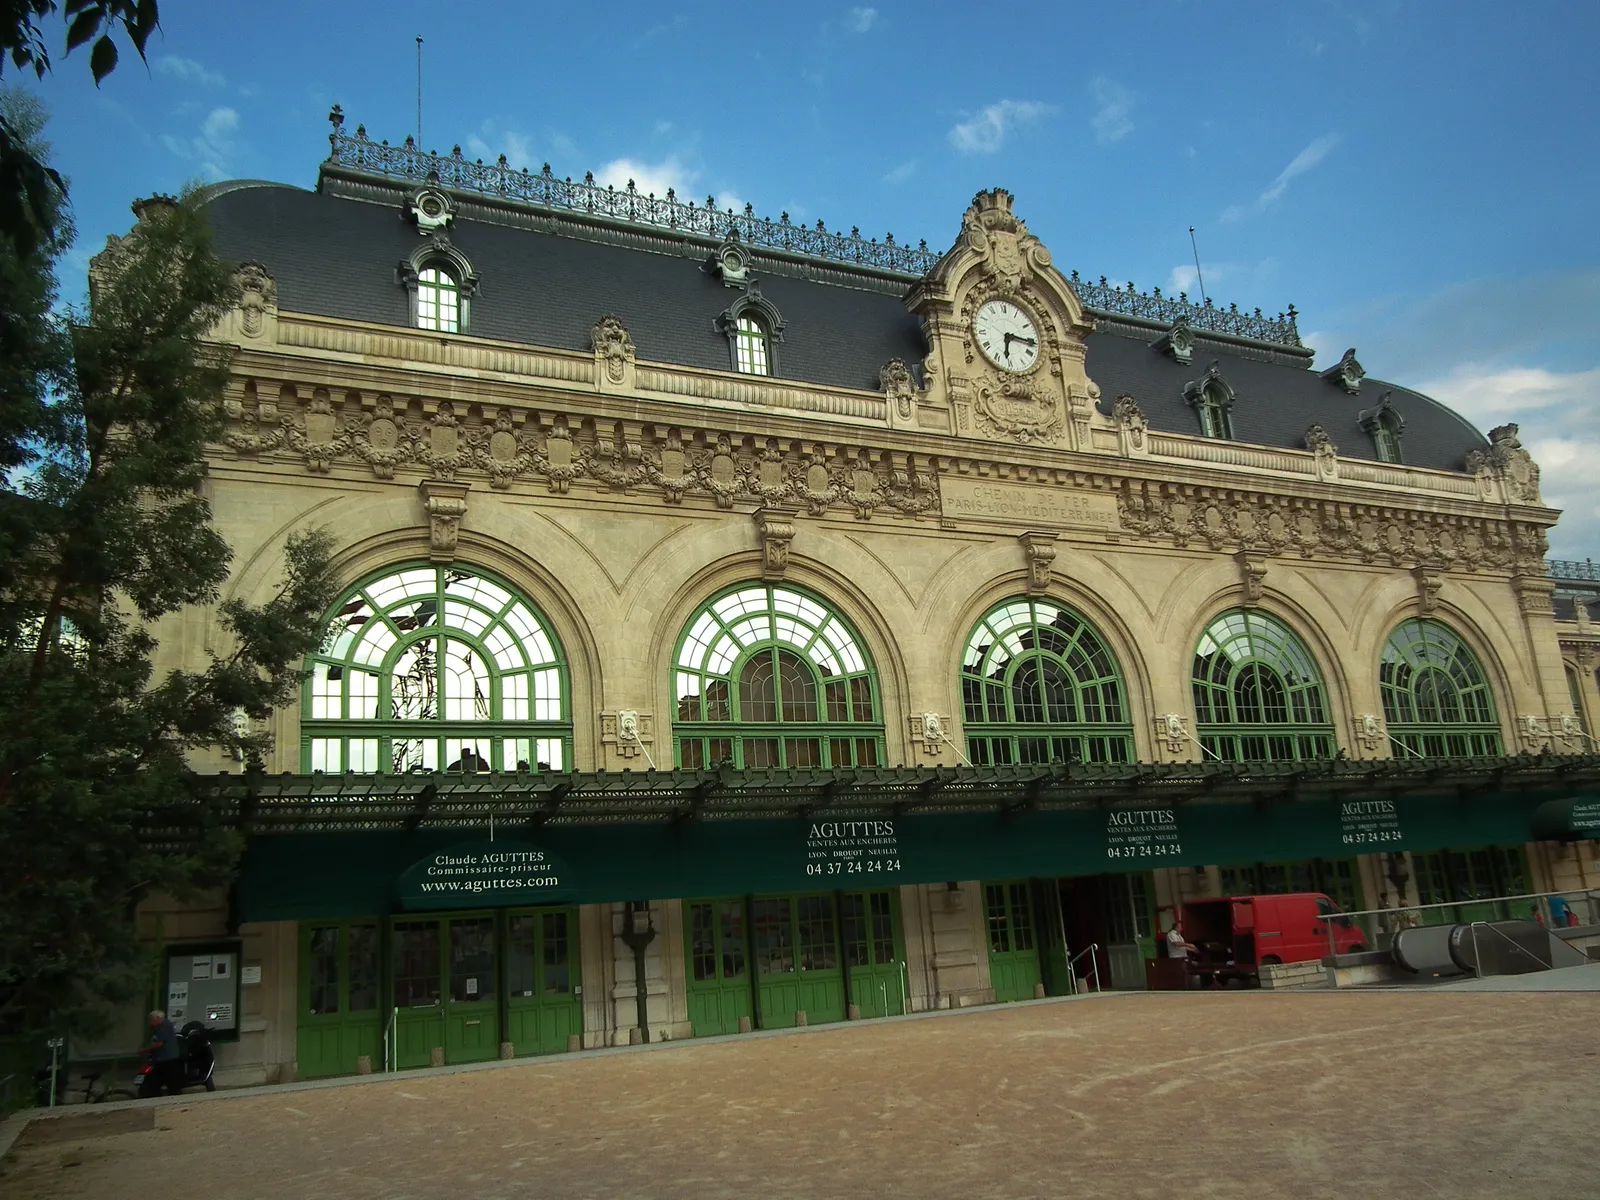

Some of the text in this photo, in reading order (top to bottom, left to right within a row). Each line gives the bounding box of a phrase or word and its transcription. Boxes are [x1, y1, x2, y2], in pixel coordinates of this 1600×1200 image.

[973, 487, 1090, 508] CHEMIN DE FER
[1342, 800, 1394, 815] AGUTTES
[1108, 810, 1174, 826] AGUTTES
[809, 821, 894, 838] AGUTTES
[1342, 830, 1402, 844] 04 37 24 24 24
[839, 838, 855, 846] AUX
[435, 851, 544, 866] Claude AGUTTES
[833, 849, 863, 857] DROUOT
[1108, 844, 1181, 858] 04 37 24 24 24
[427, 863, 552, 875] Commissaire-priseur
[806, 859, 901, 875] 04 37 24 24 24
[421, 876, 558, 892] www.aguttes.com
